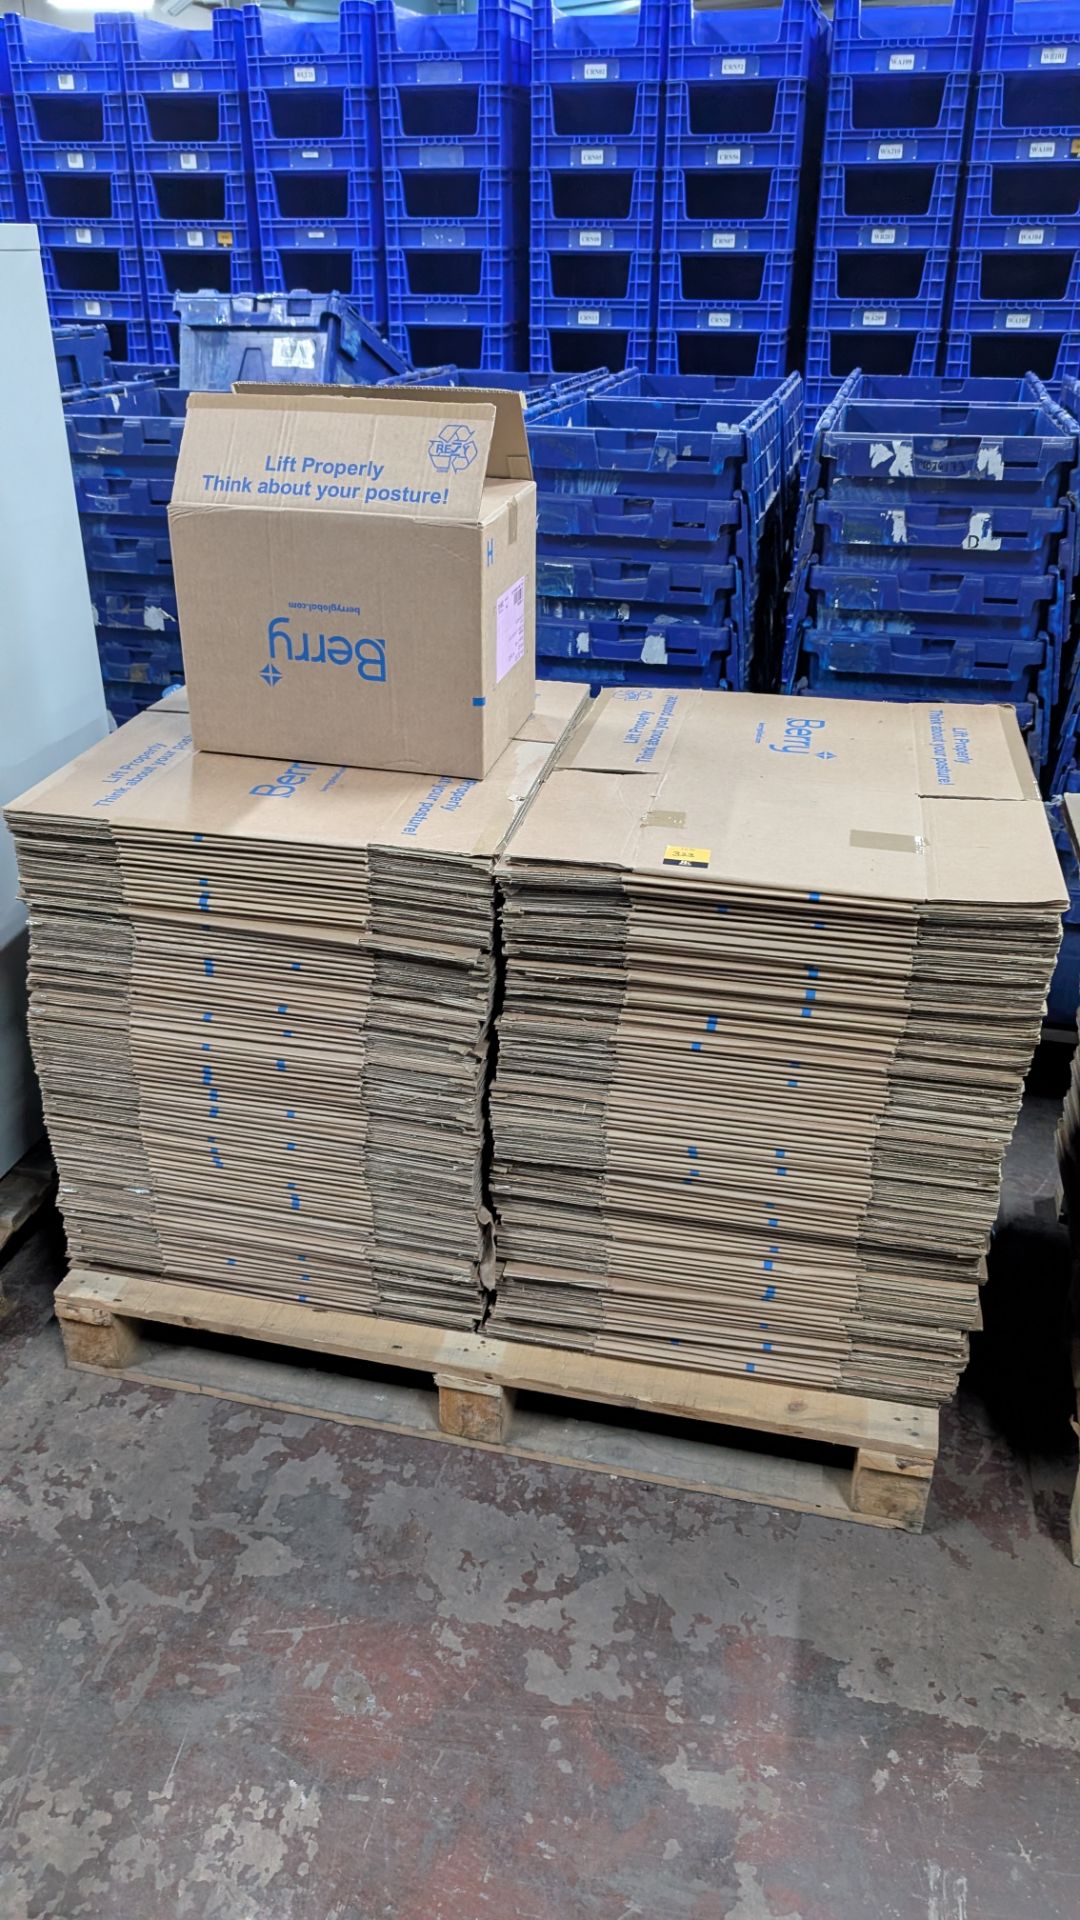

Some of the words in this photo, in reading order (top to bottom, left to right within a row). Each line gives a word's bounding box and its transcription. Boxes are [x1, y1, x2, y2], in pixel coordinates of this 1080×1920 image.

[435, 441, 472, 457] REZY
[265, 455, 297, 473] Lift
[301, 456, 385, 480] Properly
[202, 474, 252, 493] Think
[257, 479, 312, 496] about
[315, 484, 361, 501] your
[364, 487, 449, 504] posture!
[968, 535, 980, 549] D
[288, 601, 361, 616] berryglobal.com
[268, 617, 386, 682] Berry
[928, 709, 944, 724] Think
[768, 717, 826, 755] Berry
[931, 725, 946, 742] about
[102, 768, 129, 783] Lift
[119, 742, 168, 772] Properly
[929, 743, 947, 757] your
[952, 739, 974, 765] Properly
[92, 786, 134, 807] Think
[125, 765, 158, 788] about
[152, 749, 177, 767] your
[248, 762, 317, 798] Berr
[931, 758, 956, 786] posture!
[401, 801, 434, 836] posture!
